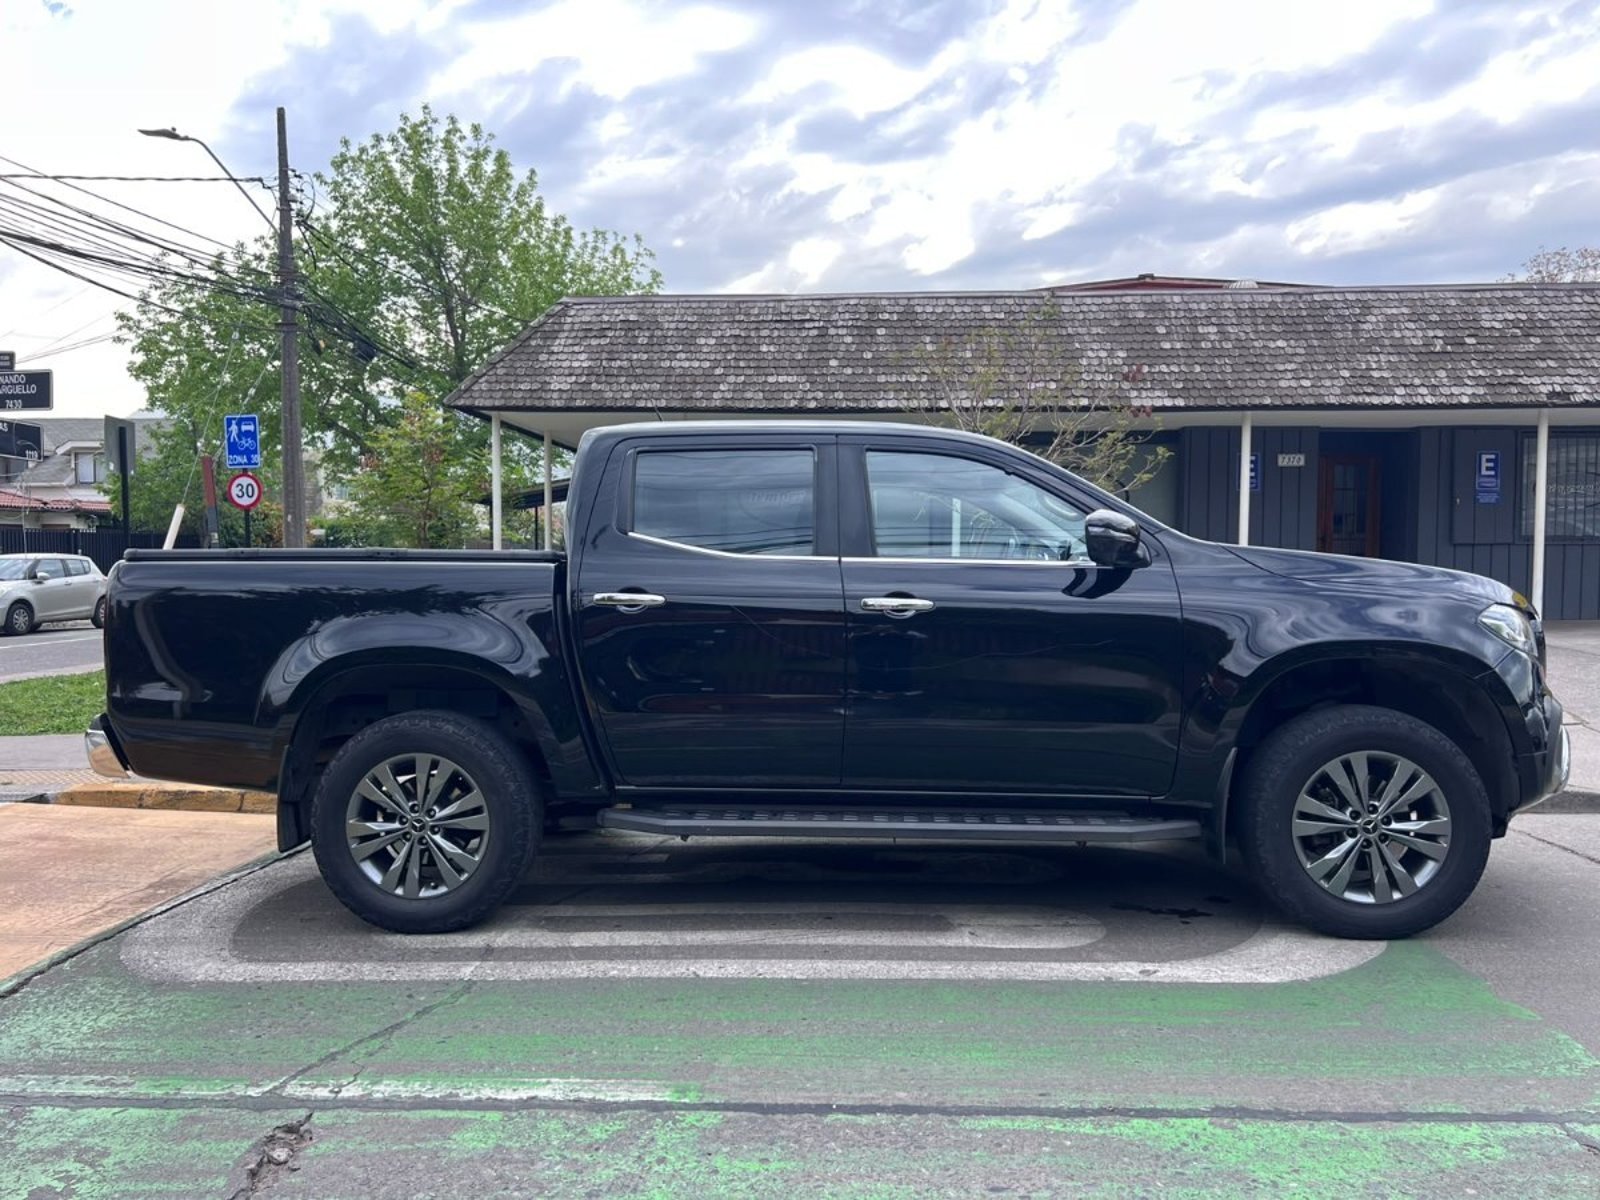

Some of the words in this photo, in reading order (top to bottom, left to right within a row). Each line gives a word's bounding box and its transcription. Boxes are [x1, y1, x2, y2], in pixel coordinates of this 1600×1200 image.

[228, 454, 248, 464] ZONA
[1481, 454, 1495, 475] E
[235, 483, 254, 498] 30
